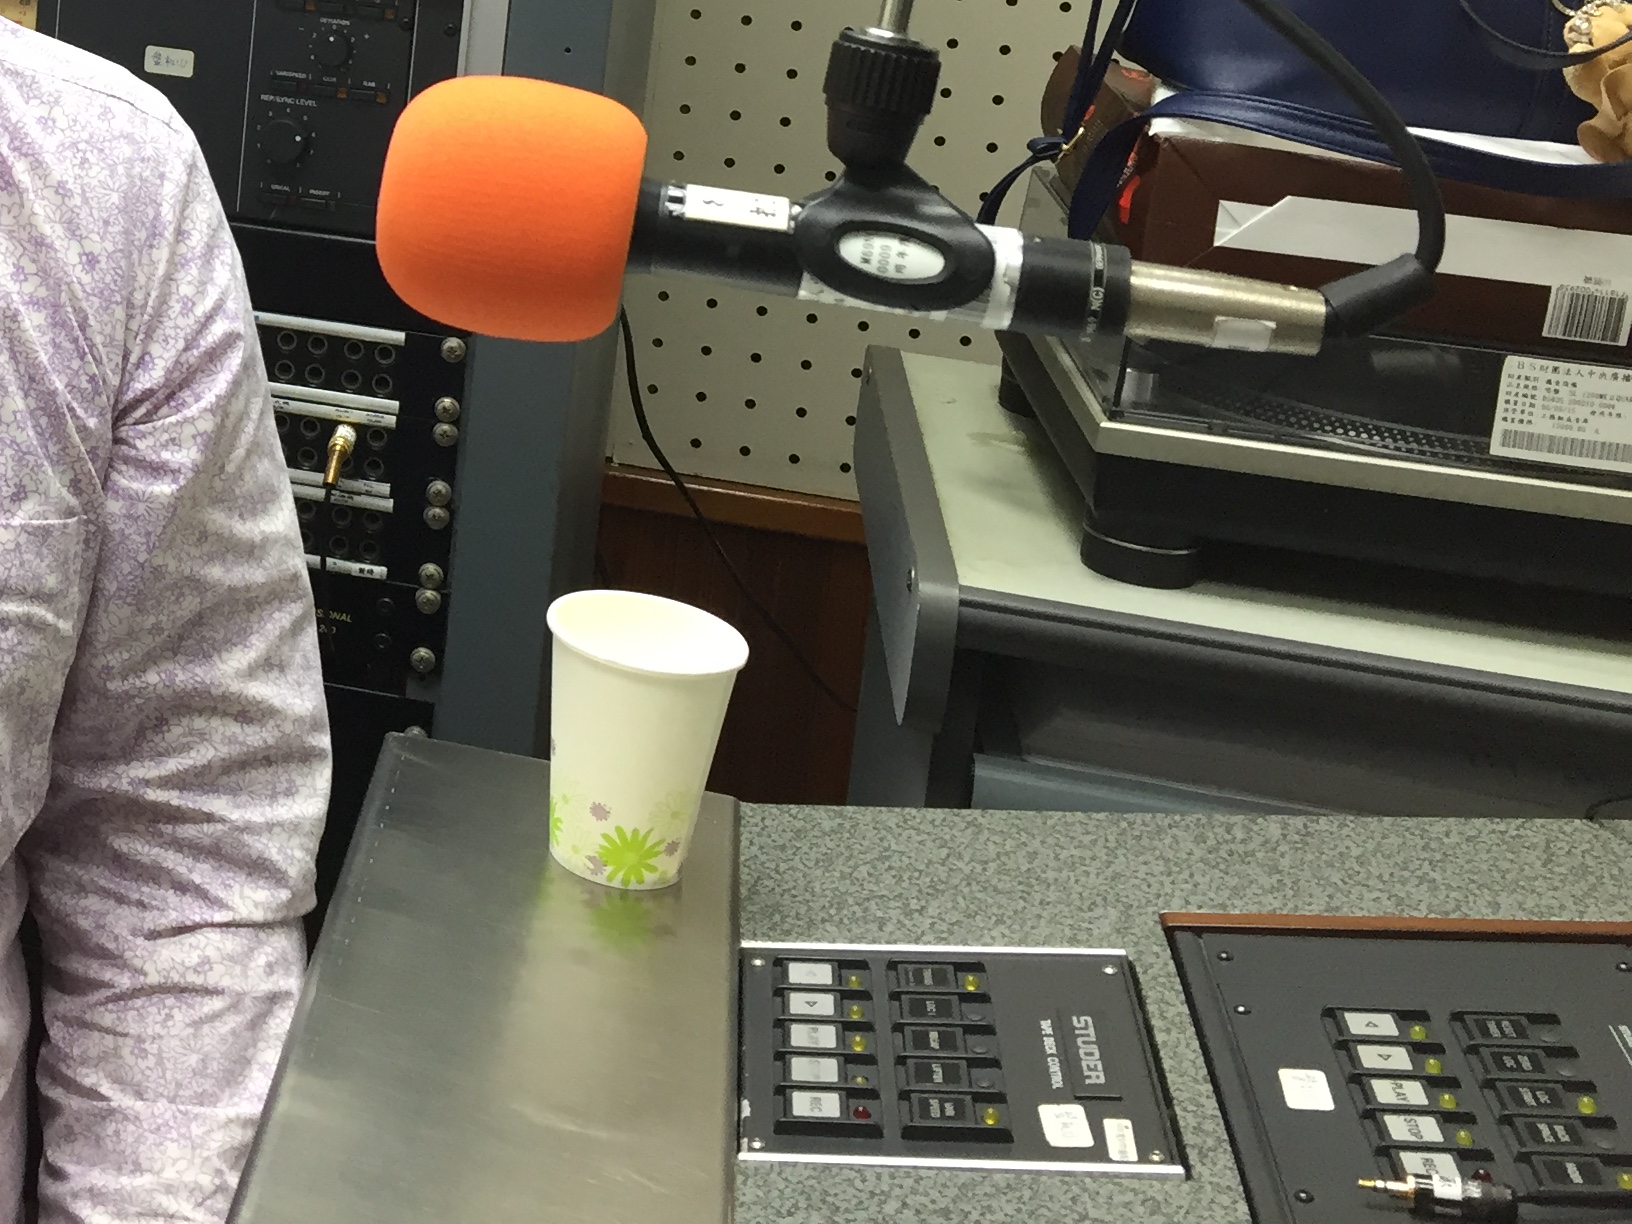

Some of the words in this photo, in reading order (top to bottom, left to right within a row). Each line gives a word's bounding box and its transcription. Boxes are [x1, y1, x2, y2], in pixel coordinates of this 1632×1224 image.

[296, 98, 317, 107] LEVEL
[1039, 1019, 1054, 1035] TAPE
[1043, 1036, 1058, 1055] DECK
[1071, 1015, 1106, 1085] STUDER
[1047, 1057, 1064, 1089] CONTROL
[1391, 1080, 1410, 1103] PLAY
[809, 1096, 823, 1113] REC
[1403, 1117, 1423, 1141] STOP
[1420, 1157, 1439, 1175] REC
